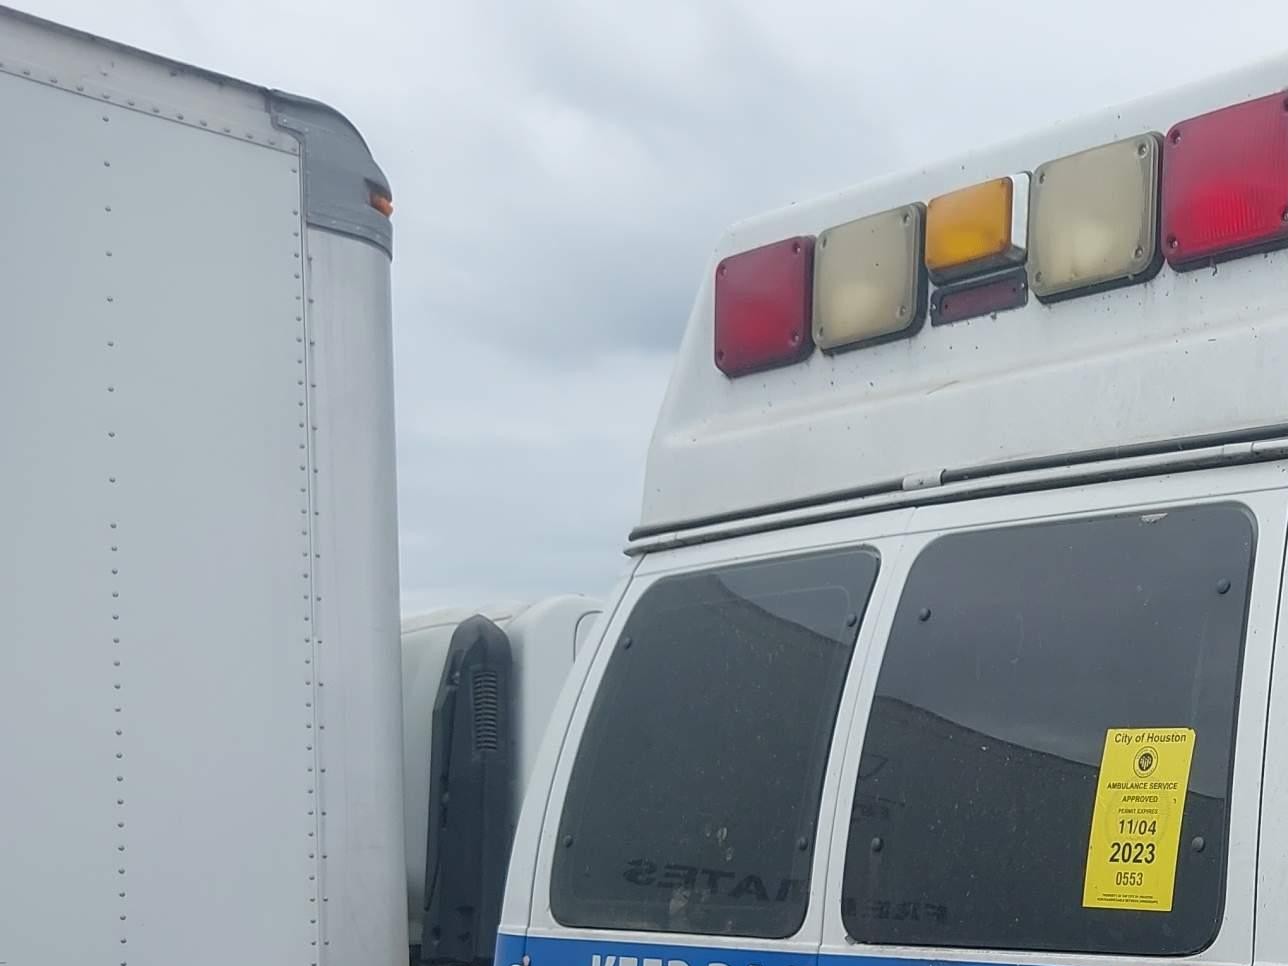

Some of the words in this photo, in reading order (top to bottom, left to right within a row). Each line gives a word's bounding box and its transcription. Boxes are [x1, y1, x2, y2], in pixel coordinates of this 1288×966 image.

[1114, 732, 1132, 746] City
[1135, 732, 1145, 743] of
[1147, 732, 1187, 743] Houston
[1107, 782, 1147, 790] AMBULANCE
[1149, 782, 1178, 790] SERVICE
[1121, 795, 1158, 803] APPROVED
[1119, 819, 1157, 836] 11/04
[1109, 842, 1156, 864] 2023
[1115, 871, 1143, 887] 0553
